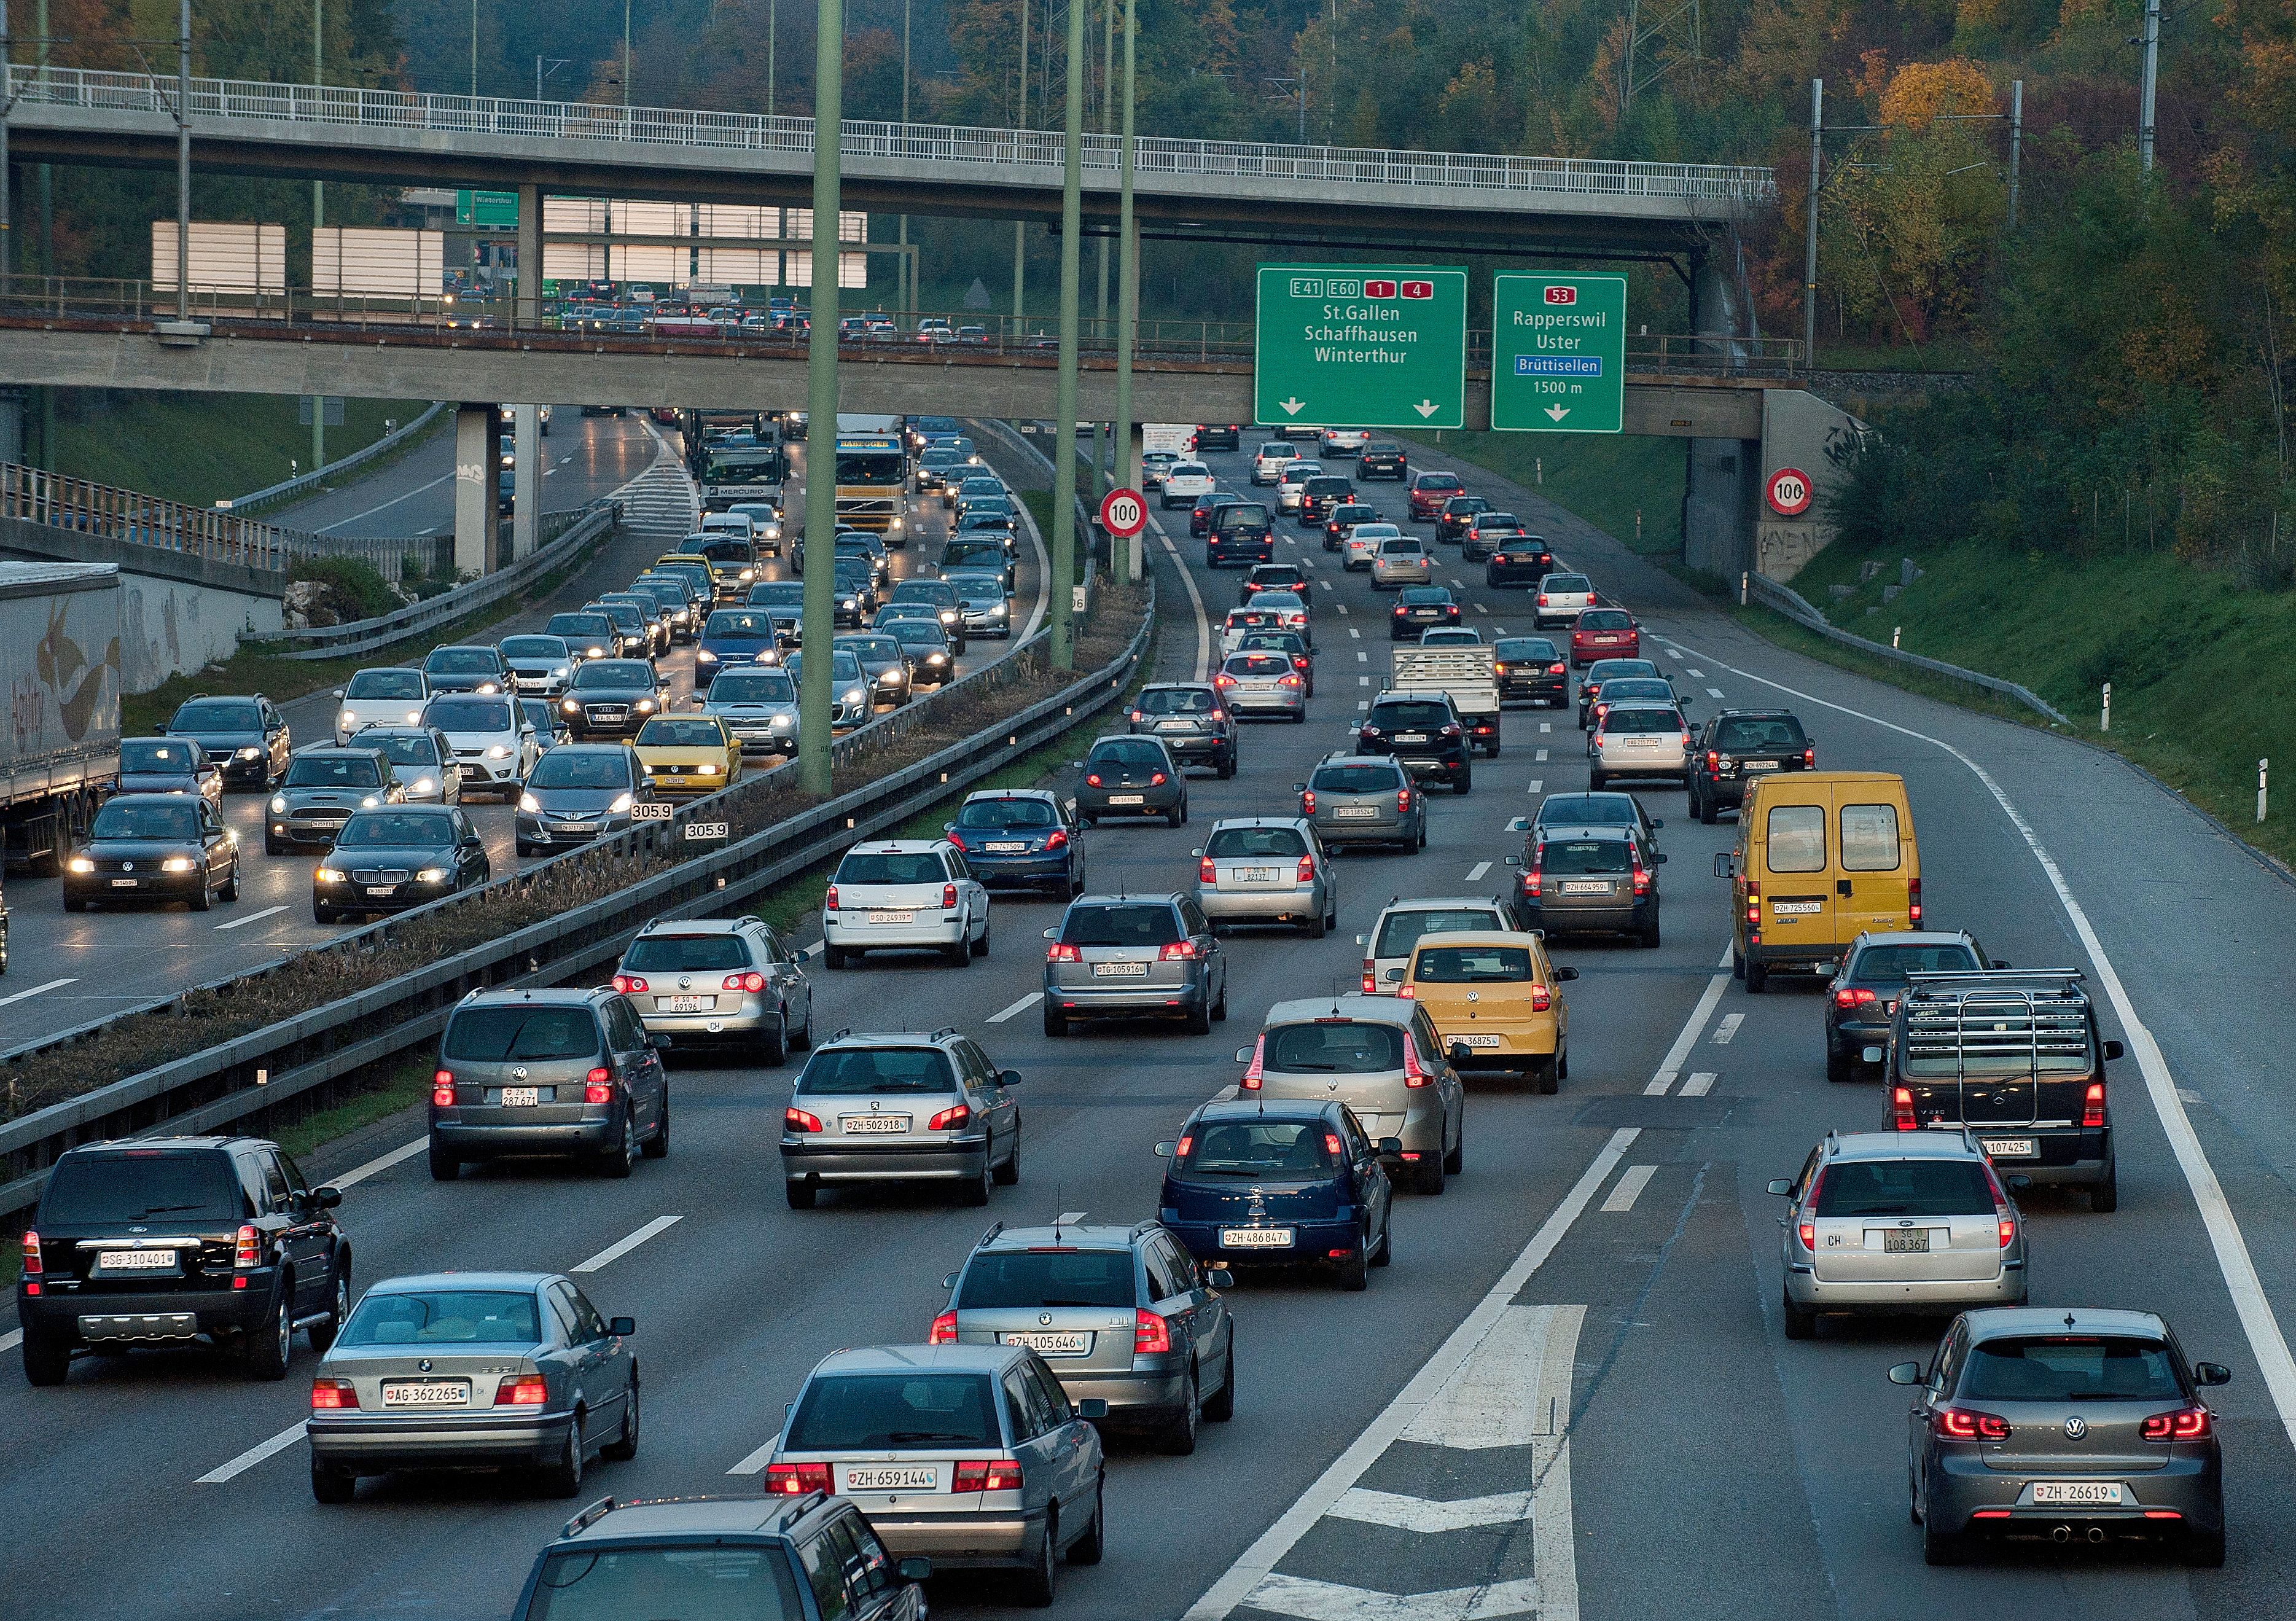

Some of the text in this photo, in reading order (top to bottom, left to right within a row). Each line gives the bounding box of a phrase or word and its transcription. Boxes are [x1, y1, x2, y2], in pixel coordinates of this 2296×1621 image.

[1377, 283, 1382, 295] 1
[1413, 284, 1421, 296] 4
[1552, 289, 1568, 302] 53
[1513, 310, 1606, 330] Rapperswil
[1305, 325, 1417, 342] Schaffhausen
[1537, 334, 1581, 350] Uster
[1314, 346, 1407, 363] Winterthur
[1520, 358, 1597, 372] Brüttisellen
[1534, 381, 1582, 394] 1500 m
[1777, 483, 1802, 499] 100
[1112, 504, 1137, 521] 100
[632, 805, 671, 818] 305.9
[688, 824, 725, 837] 305.9
[1902, 1229, 1911, 1238] SG
[1828, 1235, 1841, 1246] CH
